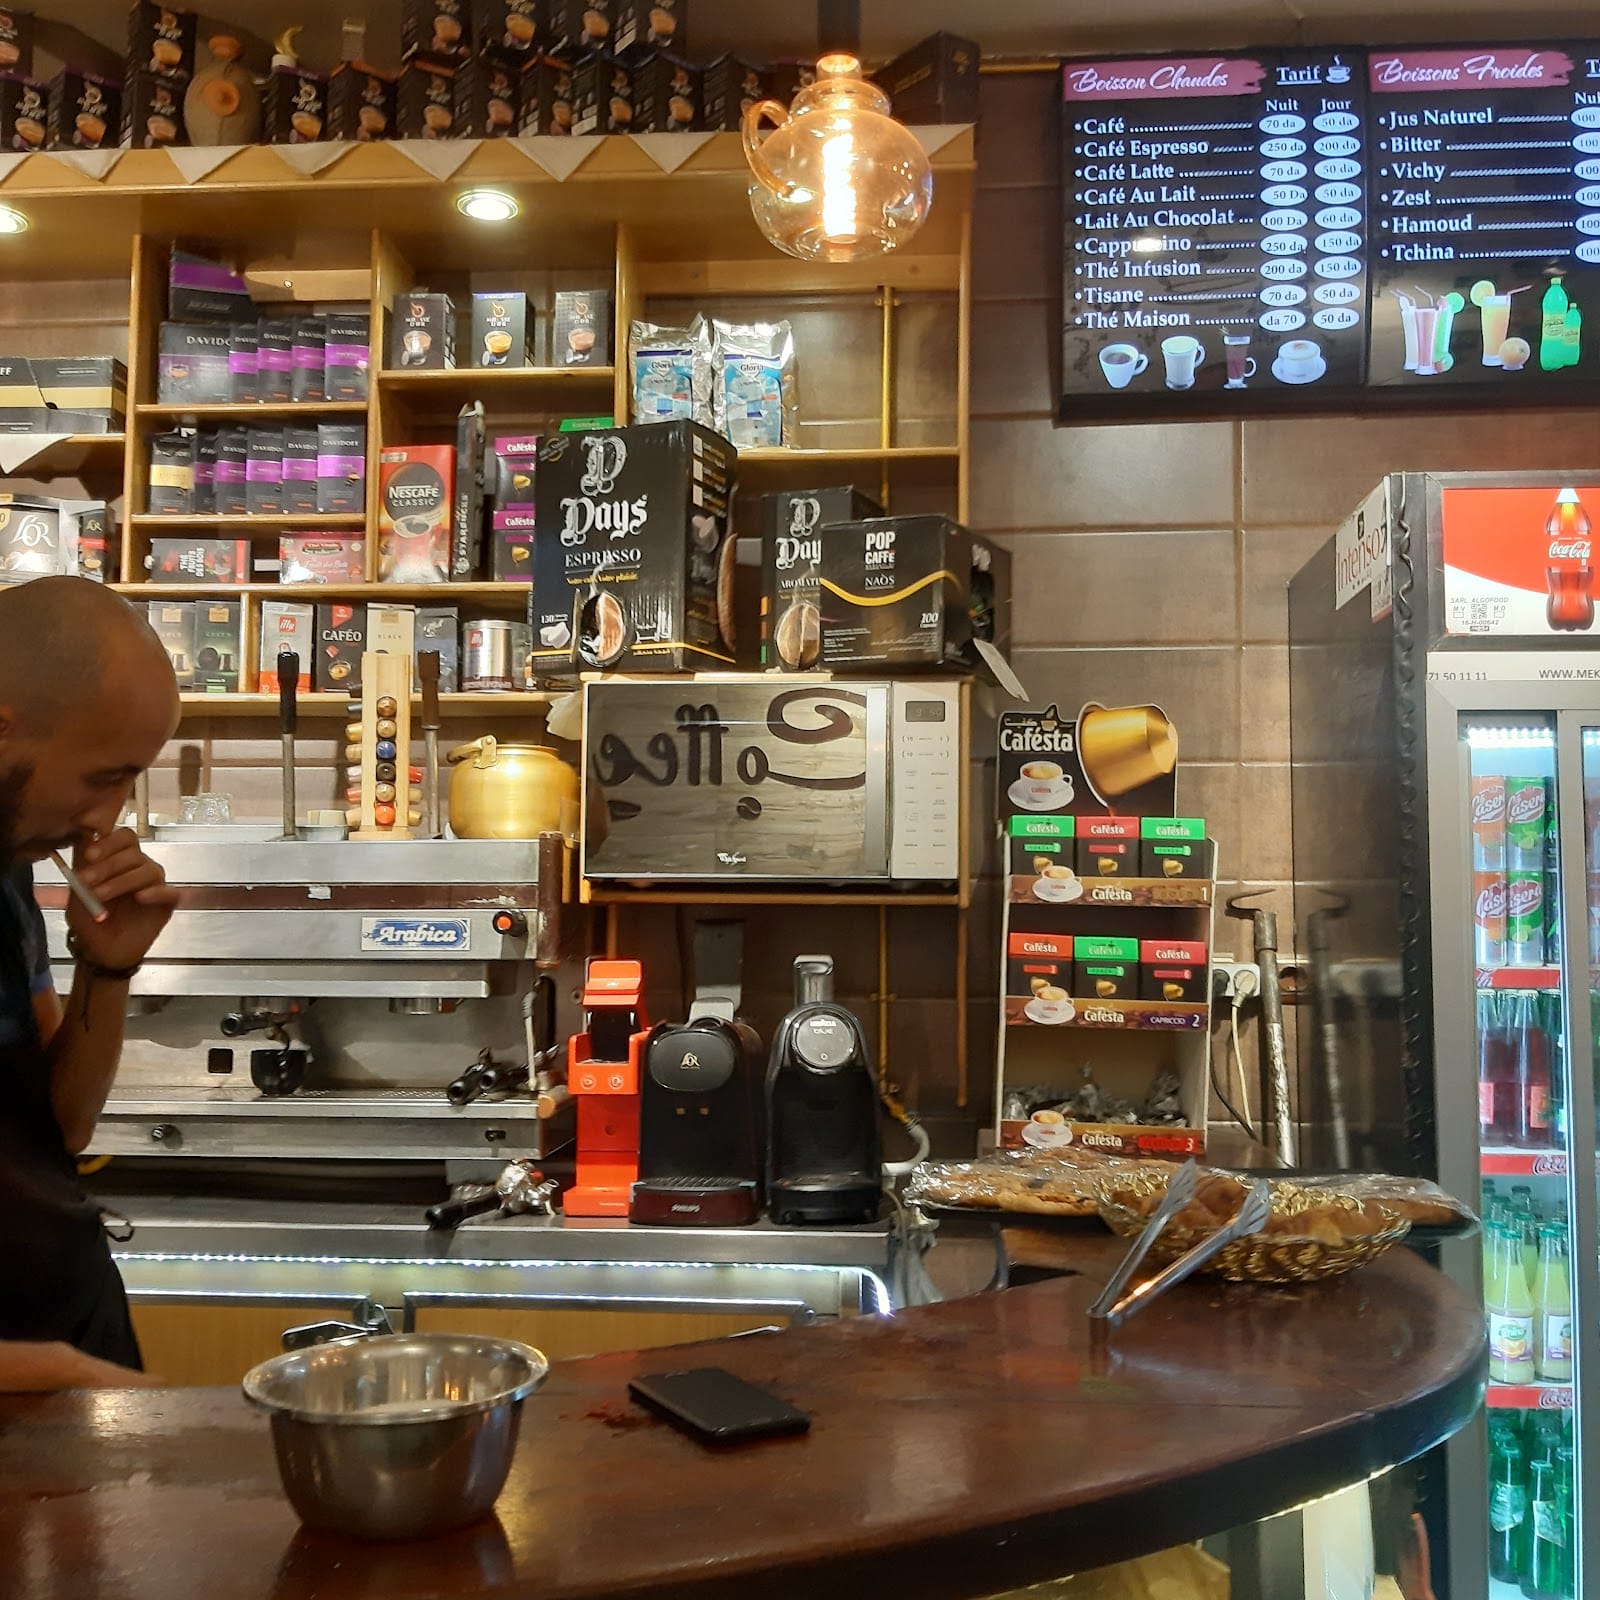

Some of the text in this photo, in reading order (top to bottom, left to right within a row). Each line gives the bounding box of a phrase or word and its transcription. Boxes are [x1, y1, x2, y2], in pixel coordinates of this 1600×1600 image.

[1276, 66, 1322, 82] Tarif
[1374, 53, 1544, 83] Boissons Froides
[1070, 63, 1228, 92] Boisson Chaudes
[1266, 99, 1298, 111] Nuit
[1320, 99, 1352, 113] Jour
[1266, 119, 1296, 128] 70 da
[1322, 117, 1353, 127] 50 da
[1389, 107, 1493, 130] Jus Naturel
[1084, 118, 1125, 134] Café
[1084, 140, 1209, 160] Café Espresso
[1267, 142, 1304, 152] 250 da
[1320, 141, 1356, 151] 200 da
[1390, 136, 1441, 152] Bitter
[1084, 164, 1174, 181] Café Latte
[1270, 166, 1300, 177] 70 da
[1323, 164, 1353, 174] 50 da
[1392, 161, 1446, 182] Vichy
[1084, 185, 1196, 205] Café Au Lait
[1273, 190, 1305, 200] 50 Da
[1323, 187, 1354, 198] 50 da
[1392, 189, 1432, 206] Zest
[1084, 208, 1234, 229] Lait Au Chocolat
[1264, 217, 1302, 226] 100 Da
[1322, 213, 1353, 224] 60 da
[1392, 213, 1473, 234] Hamoud
[1084, 236, 1192, 257] Cappino
[1266, 241, 1303, 252] 250 da
[1322, 237, 1359, 248] 150 da
[1392, 244, 1454, 261] Tchina
[1084, 261, 1201, 279] Thé Infusion
[1265, 264, 1302, 274] 200 da
[1321, 261, 1357, 273] 150 da
[1084, 288, 1143, 303] Tisane
[1269, 291, 1298, 301] 70 da
[1322, 288, 1353, 299] 50 da
[1084, 310, 1191, 328] Thé Maison
[1266, 315, 1297, 325] da 70
[1320, 313, 1351, 324] 50 da
[393, 499, 435, 507] CLASSIC
[865, 531, 896, 551] POP
[541, 615, 554, 624] 130
[921, 612, 939, 623] 100
[280, 619, 296, 631] illy
[322, 628, 362, 642] CAFÉO
[1000, 727, 1074, 752] Cafésta
[1026, 822, 1060, 834] Cafésta
[1090, 824, 1125, 835] Cafésta
[1156, 826, 1190, 837] Cafésta
[1092, 886, 1207, 901] Cafésta 1
[375, 924, 457, 943] Arabica
[1024, 942, 1057, 953] Cafésta
[1088, 945, 1124, 956] Cafésta
[1156, 949, 1190, 961] Cafésta
[1084, 1008, 1200, 1027] Cafésta CAPRICCIO 2
[1082, 1132, 1194, 1151] Cafésta 3
